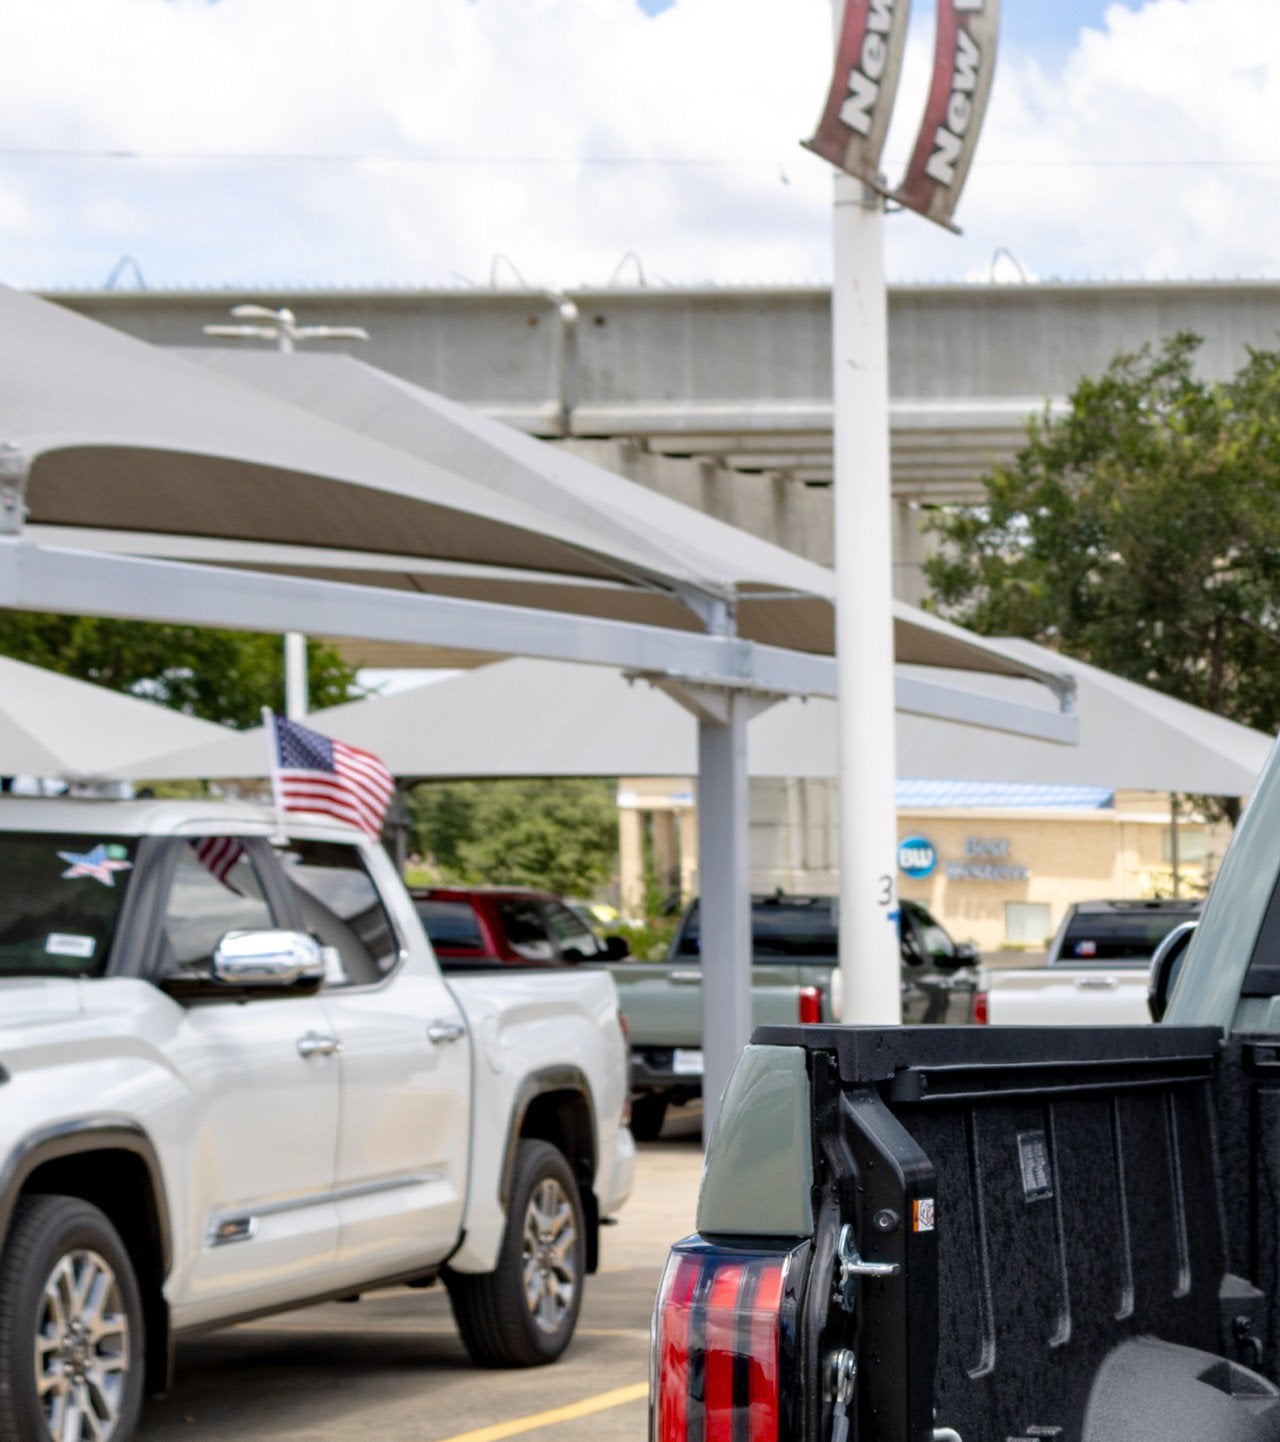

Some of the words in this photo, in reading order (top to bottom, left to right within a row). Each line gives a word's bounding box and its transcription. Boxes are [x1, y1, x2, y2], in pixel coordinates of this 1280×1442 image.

[924, 28, 981, 186] New
[900, 847, 933, 869] BW
[877, 874, 894, 906] 3
